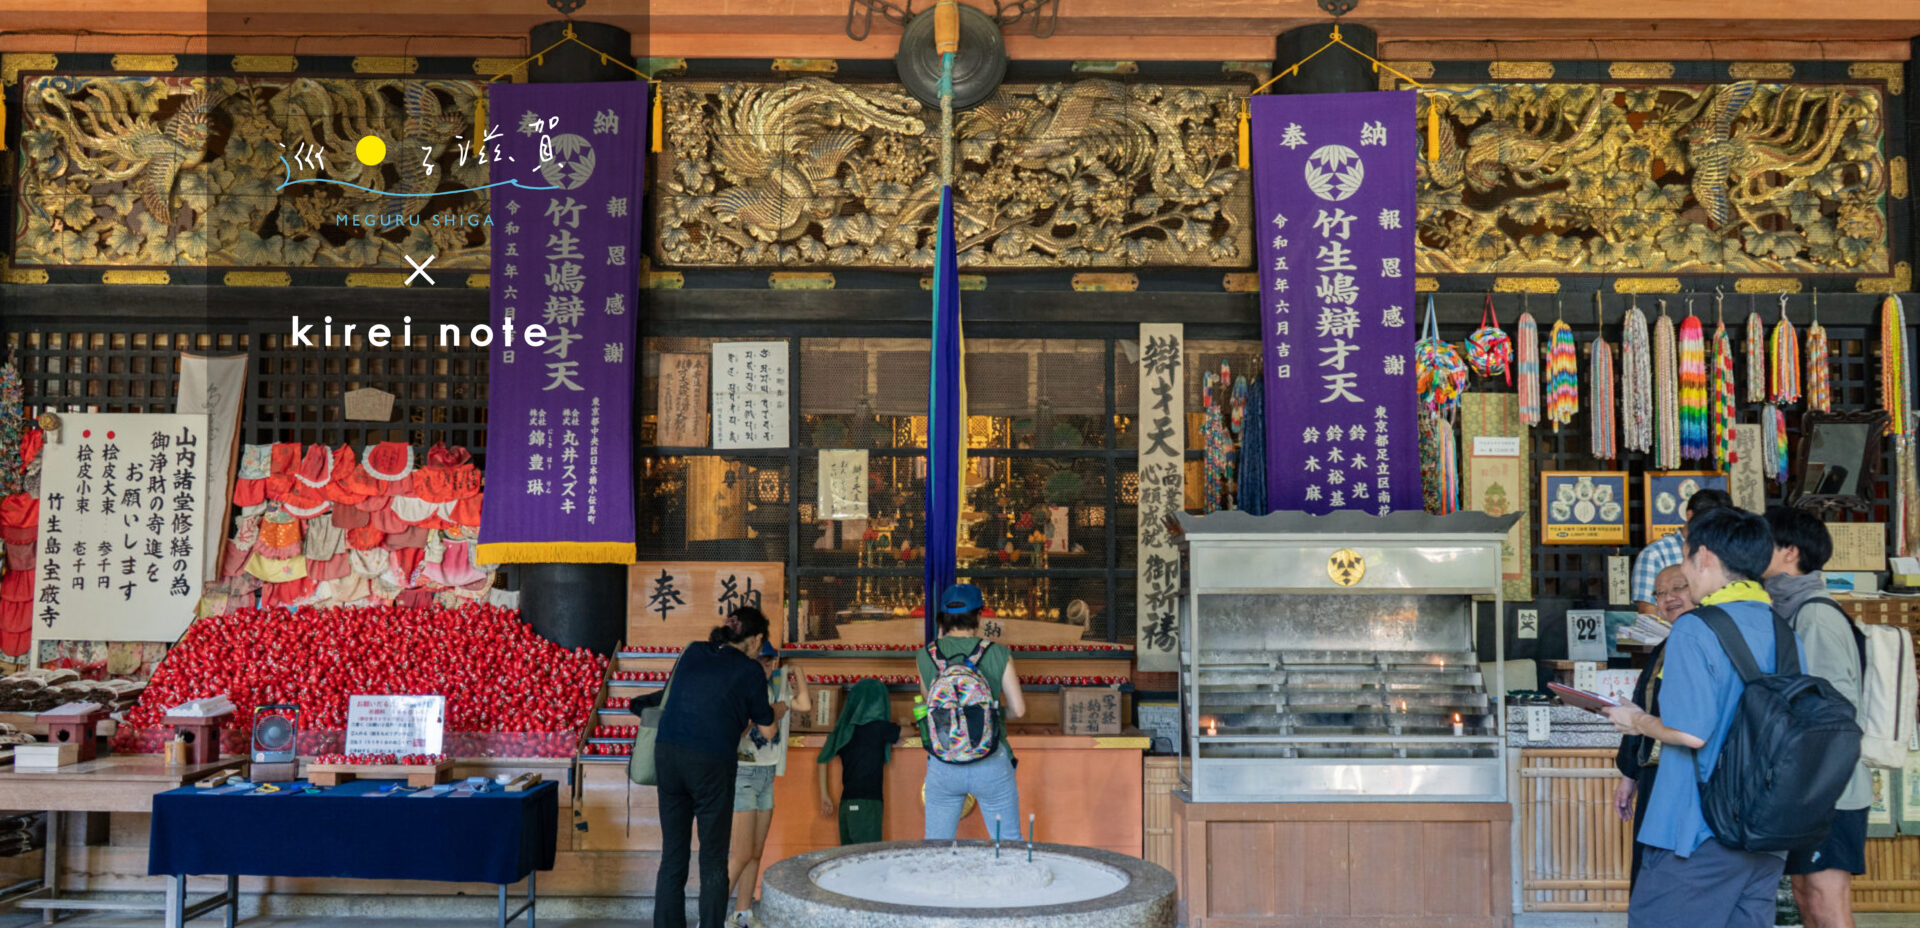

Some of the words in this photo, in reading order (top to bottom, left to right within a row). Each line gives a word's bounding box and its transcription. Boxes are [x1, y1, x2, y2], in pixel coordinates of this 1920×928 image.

[502, 199, 521, 364] 令和五年六月日
[603, 196, 628, 364] 報恩感謝
[1271, 213, 1292, 379] 令和五年六月吉日
[1378, 208, 1406, 376] 報恩感謝
[75, 444, 94, 514] 桧皮小束
[100, 443, 120, 515] 桧皮大束
[143, 431, 170, 583] 御浄財の寄進を
[169, 426, 197, 597] 山内諸堂修繕の為
[1302, 426, 1323, 517] 鈴木麻
[1349, 424, 1370, 499] 鈴木光
[1374, 405, 1391, 518] 東京都足立区南花
[39, 492, 64, 628] 竹生島宝厳寺
[71, 541, 87, 591] 壱千円
[118, 462, 143, 601] お願いします
[645, 568, 762, 622] 奉納
[1576, 618, 1597, 640] 22
